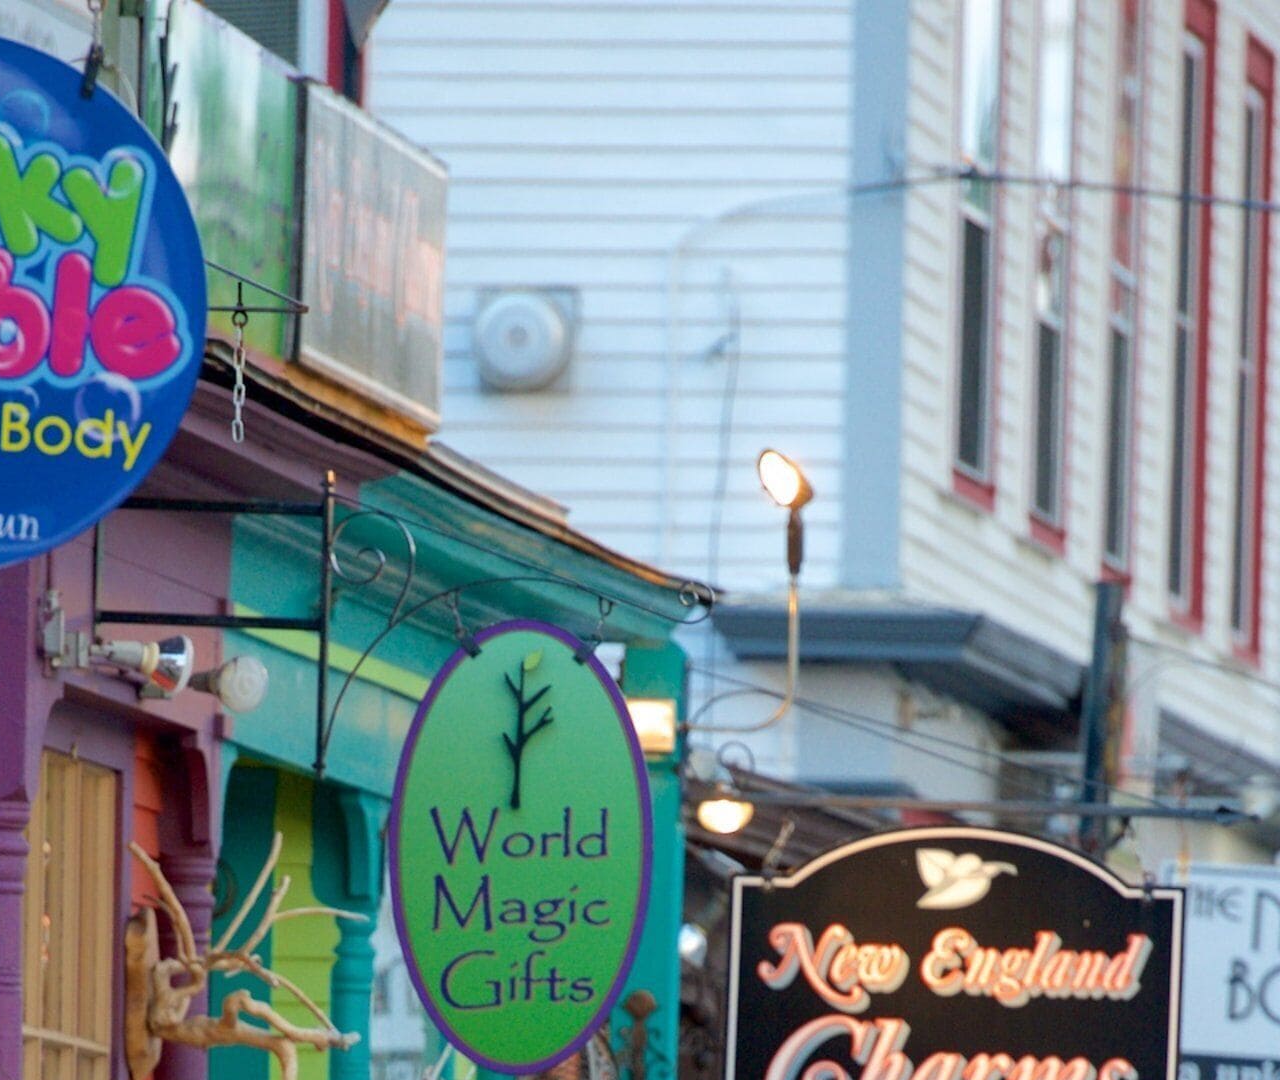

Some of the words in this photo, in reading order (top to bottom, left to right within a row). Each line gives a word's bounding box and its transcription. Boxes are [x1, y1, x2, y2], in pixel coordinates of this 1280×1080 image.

[0, 402, 152, 472] Body
[428, 806, 609, 866] World
[430, 872, 611, 944] Magic
[439, 949, 596, 1011] Gifts
[756, 921, 911, 1014] New
[920, 925, 1154, 1009] England
